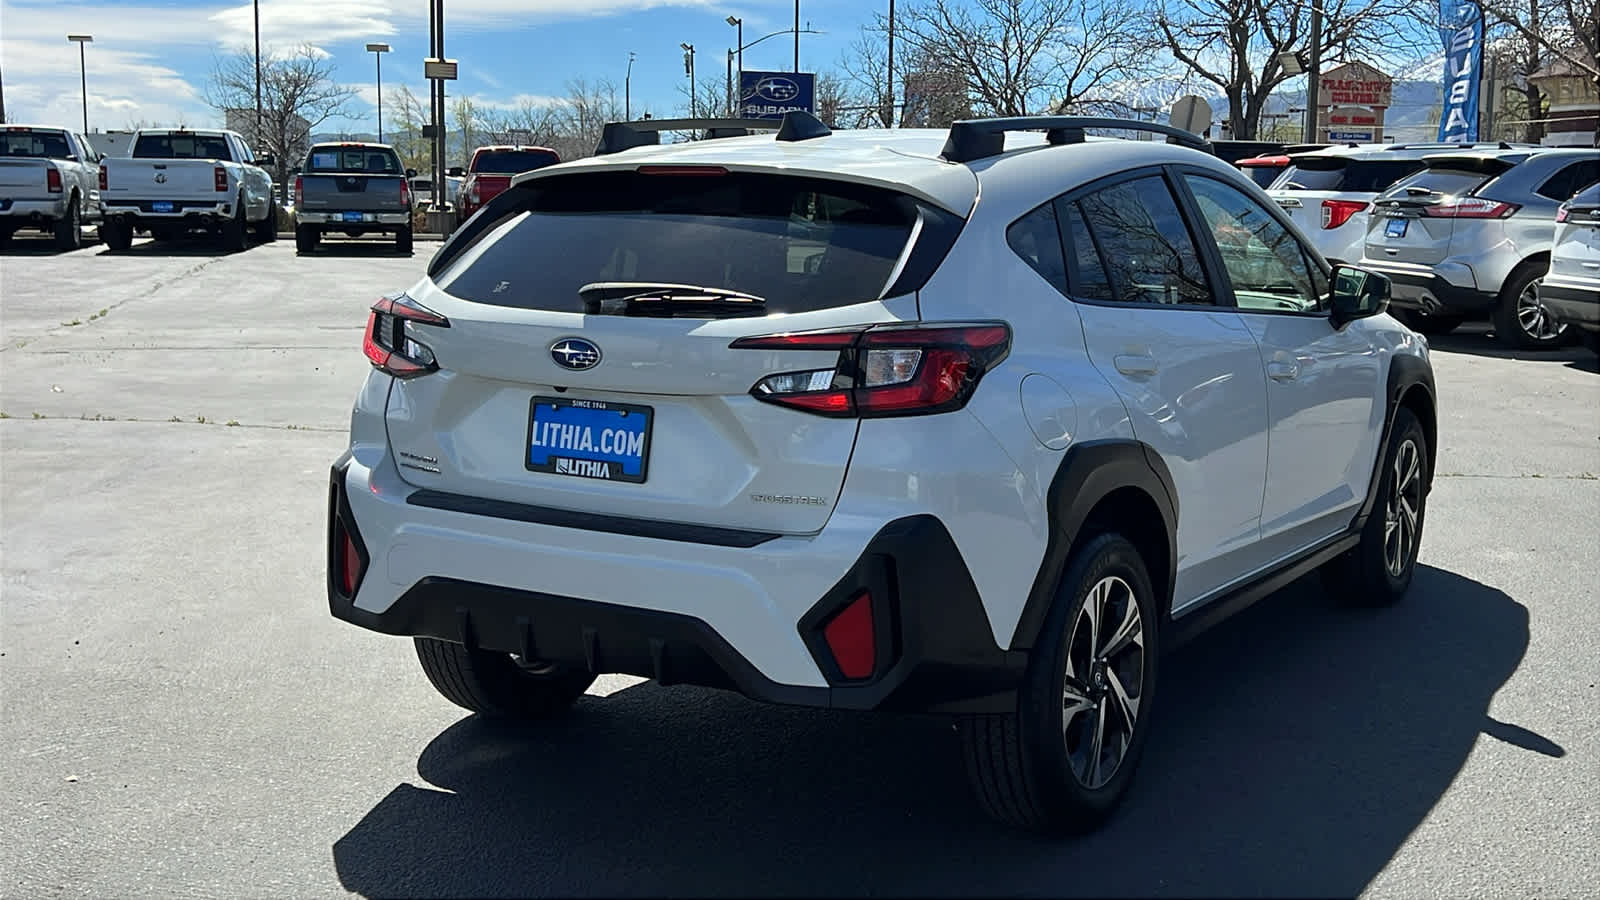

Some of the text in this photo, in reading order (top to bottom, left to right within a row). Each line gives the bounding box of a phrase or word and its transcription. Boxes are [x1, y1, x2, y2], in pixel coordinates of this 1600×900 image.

[572, 399, 591, 409] SINCE
[531, 420, 645, 457] LITHIA.COM
[568, 459, 610, 478] LITHIA
